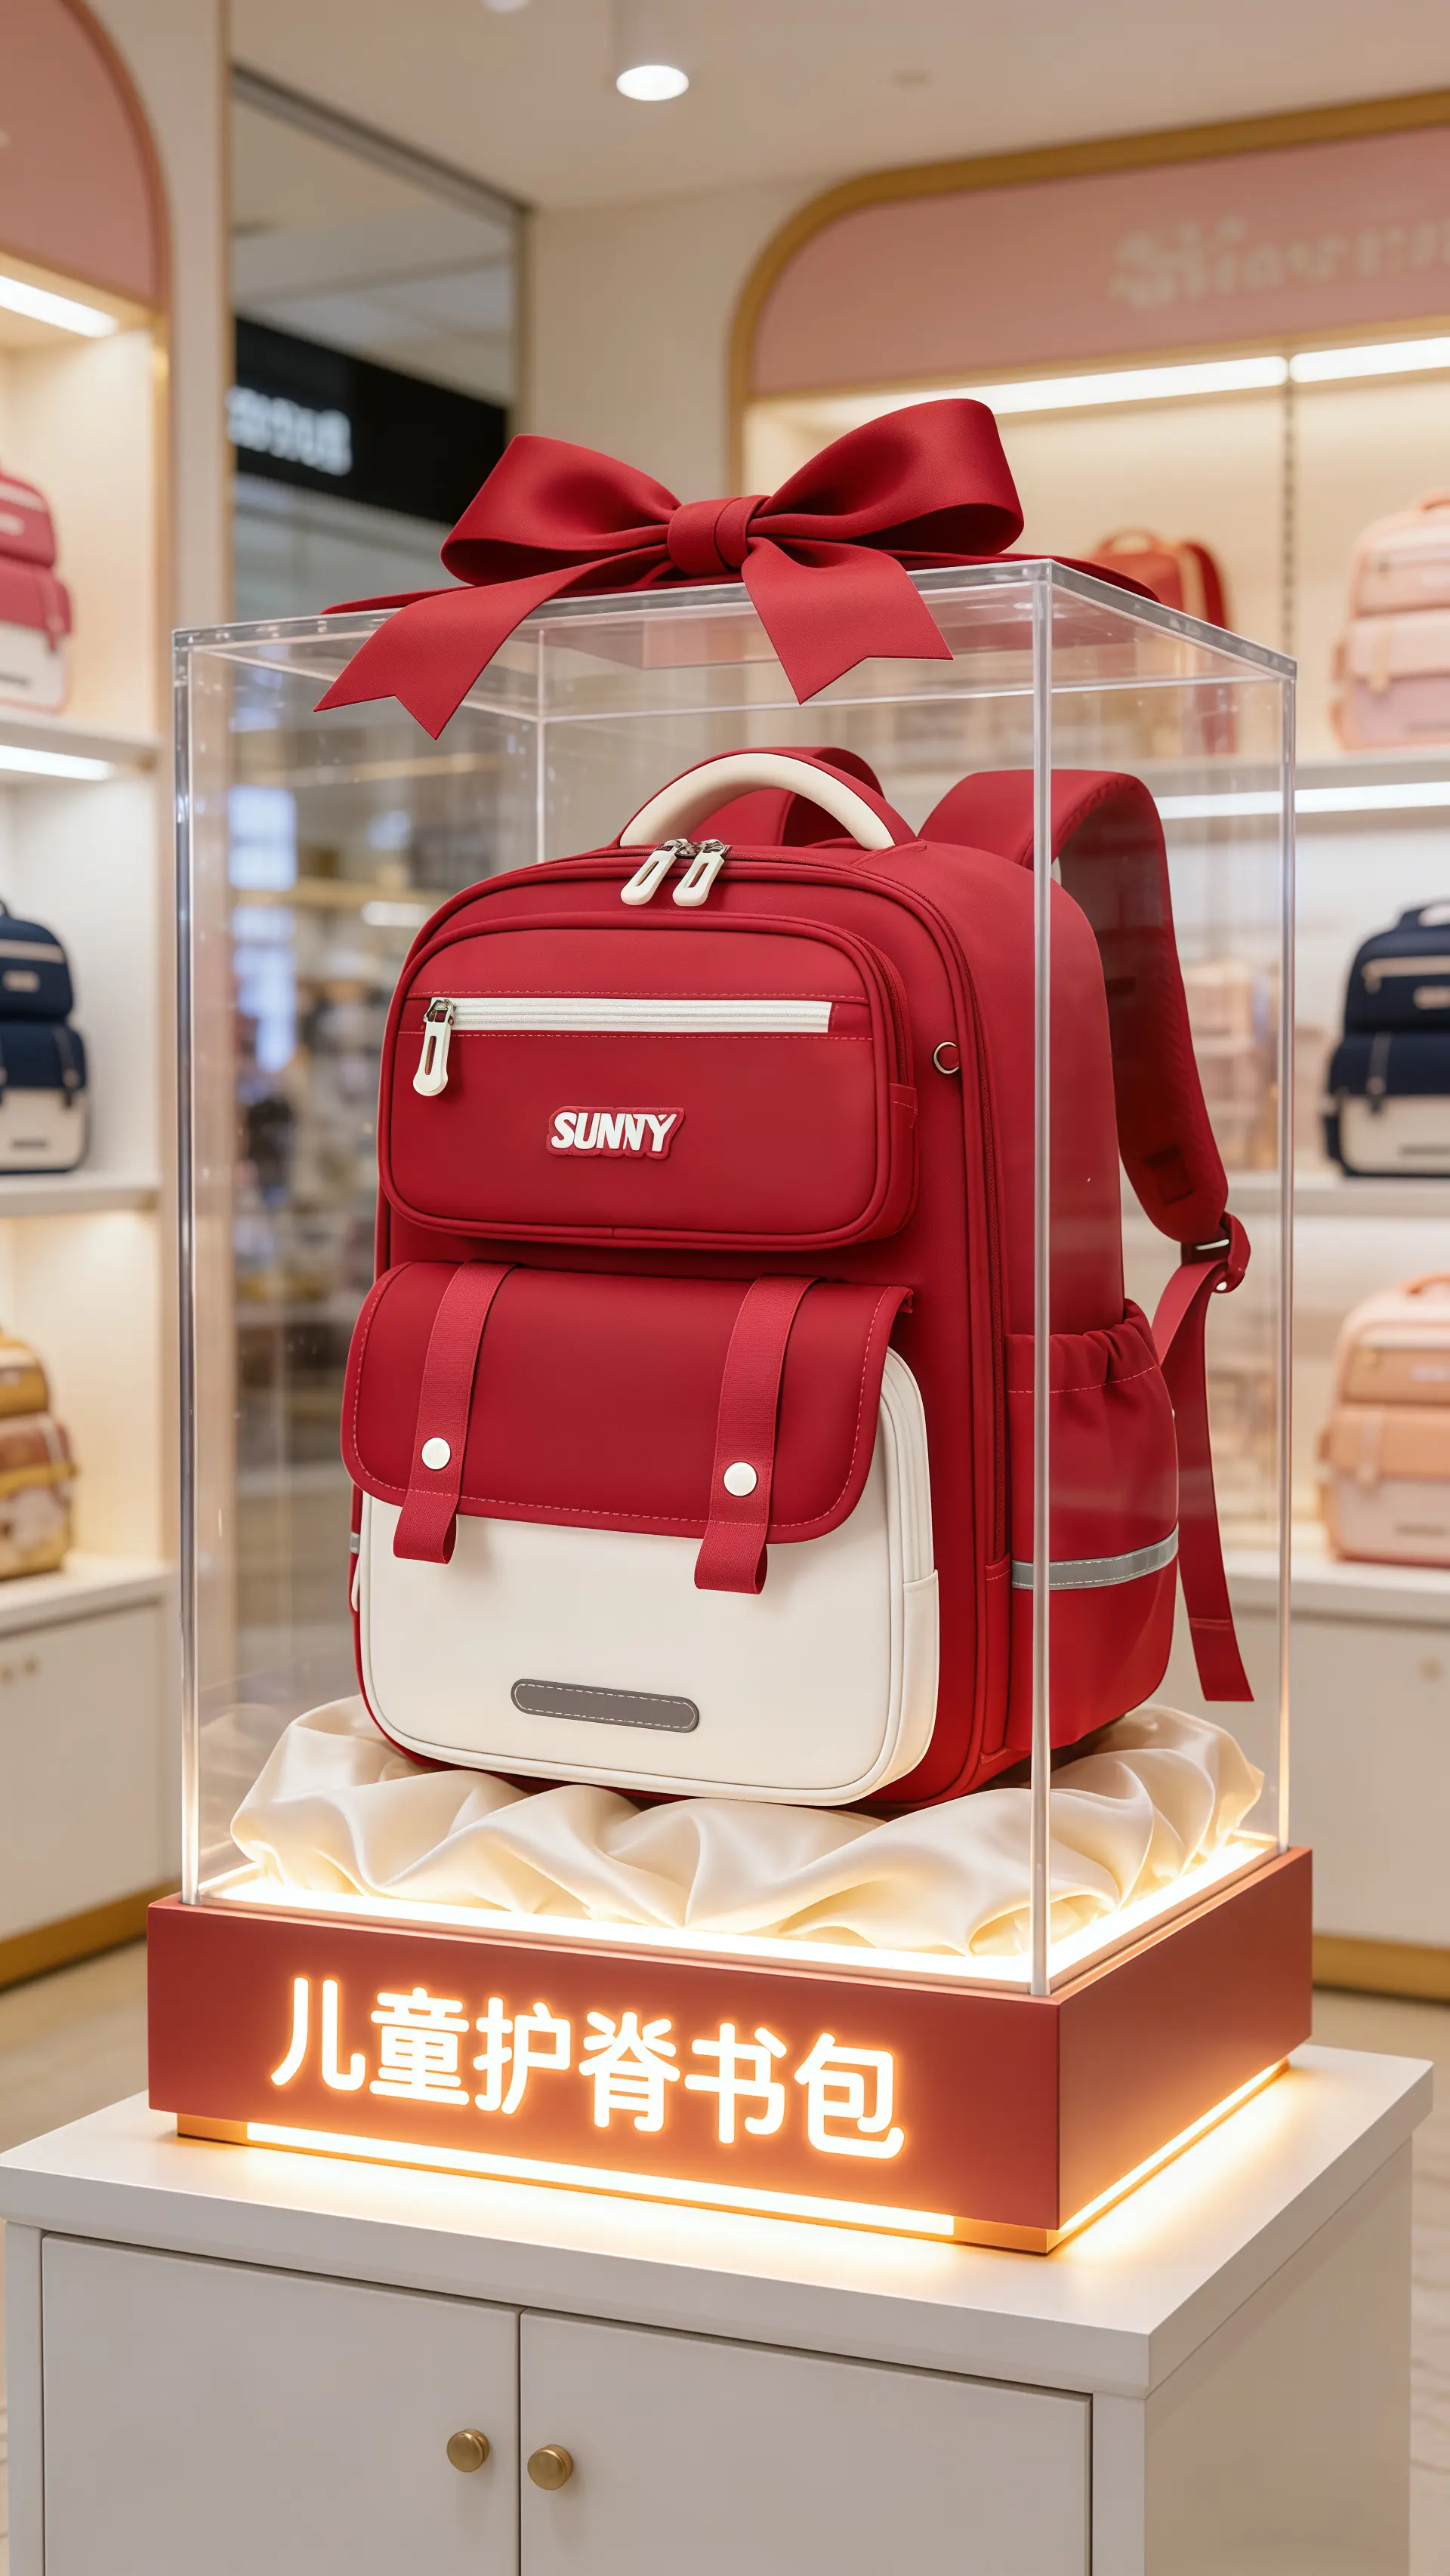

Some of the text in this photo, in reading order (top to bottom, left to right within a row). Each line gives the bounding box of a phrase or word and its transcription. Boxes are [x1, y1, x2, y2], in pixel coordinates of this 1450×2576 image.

[270, 1977, 905, 2160] 儿童护脊书包
